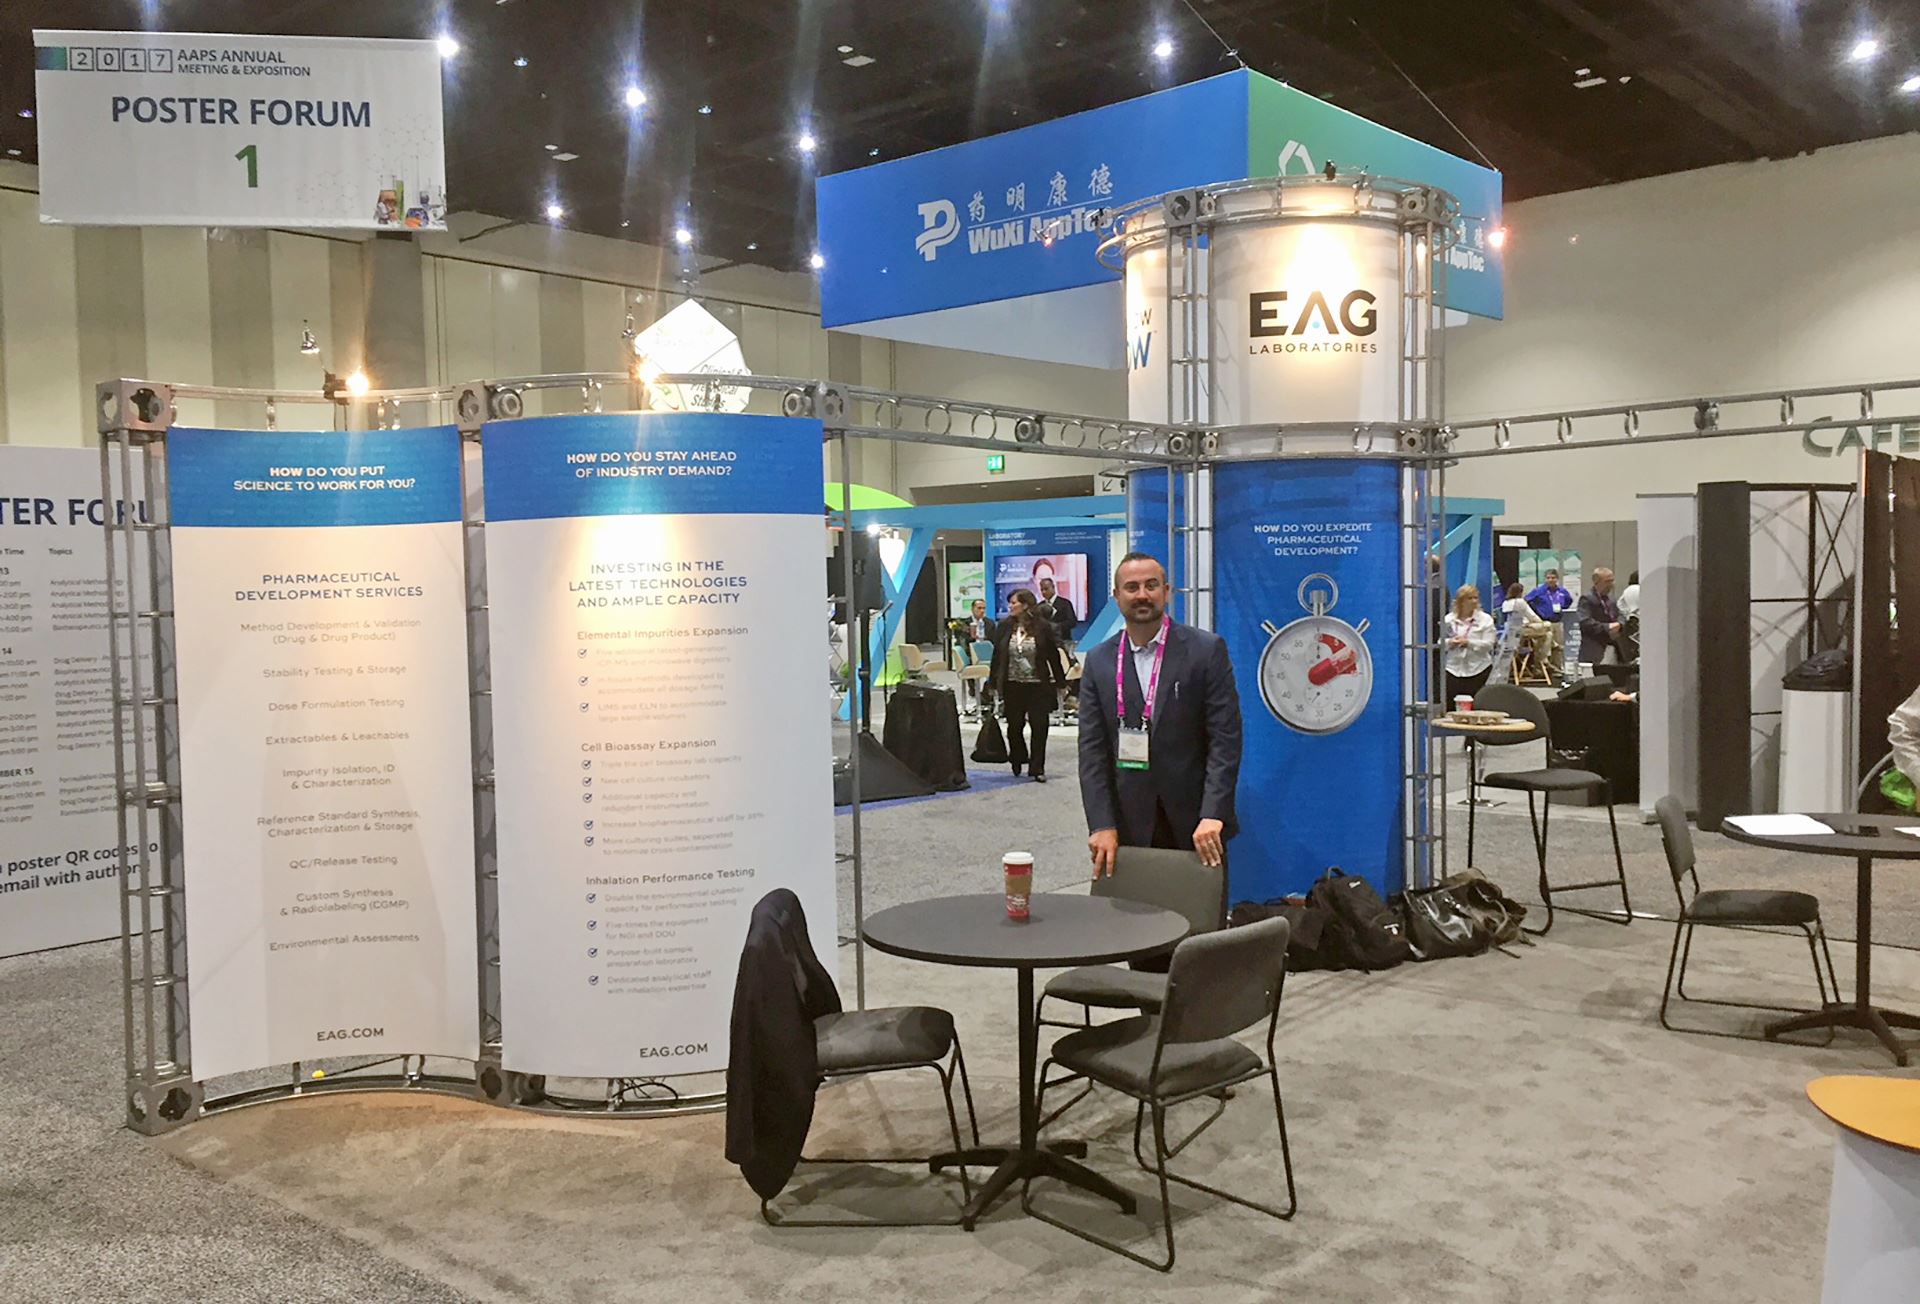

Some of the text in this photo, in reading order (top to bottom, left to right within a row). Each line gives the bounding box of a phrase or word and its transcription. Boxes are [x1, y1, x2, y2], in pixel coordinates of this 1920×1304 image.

[177, 49, 218, 63] AAPS
[221, 50, 286, 64] ANNUAL
[178, 64, 311, 77] MEETING & EXPOSITION
[112, 96, 372, 128] POSTER FORUM
[235, 144, 259, 188] 1
[968, 220, 1024, 254] WuXi
[1250, 288, 1377, 338] EAG
[1249, 341, 1378, 355] LABORATORIES
[567, 451, 737, 464] HOW DO YOU STAY AHEAD
[270, 466, 386, 477] HOW DO YOU PUT
[575, 465, 733, 478] OF INDUSTRY DEMAND?
[233, 478, 416, 491] SCIENCE TO WORK FOR YOU?
[1254, 523, 1372, 533] HOW DO YOU EXPEDITE
[1267, 535, 1362, 544] PHARMACEUTICAL
[1274, 547, 1359, 556] DEVELOPMENT?
[591, 560, 724, 575] INVESTING IN THE
[262, 572, 400, 585] PHARMACEUTICAL
[569, 576, 747, 592] LATEST TECHNOLOGIES
[235, 586, 423, 601] DEVELOPMENT SERVICES
[577, 593, 740, 608] AND AMPLE CAPACITY
[240, 618, 421, 632] Method Development & Validation
[273, 631, 396, 645] (Drug & Drug Product)
[577, 626, 749, 640] Elemental Impurities Expansion
[263, 664, 407, 678] Stability Testing & Storage
[268, 698, 405, 711] Dose Formulation Testing
[265, 731, 410, 745] Extractables & Leachables
[581, 739, 717, 753] Cell Bioassay Expansion
[282, 764, 395, 778] Impurity Isolation, ID
[291, 777, 391, 790] & Characterization
[257, 814, 315, 825] Reference
[318, 810, 368, 821] Standard
[268, 822, 413, 838] Characterization & Storage
[8, 855, 61, 876] poster
[65, 850, 89, 866] QR
[289, 855, 398, 869] QC/Release Testing
[44, 869, 80, 886] with
[586, 867, 755, 886] Inhalation Performance Testing
[296, 889, 394, 902] Custom Synthesis
[280, 908, 288, 916] &
[292, 902, 367, 915] Radiolabeling
[269, 933, 420, 951] Environmental Assessments
[317, 1027, 384, 1042] EAG.COM
[639, 1042, 709, 1058] EAG.COM
